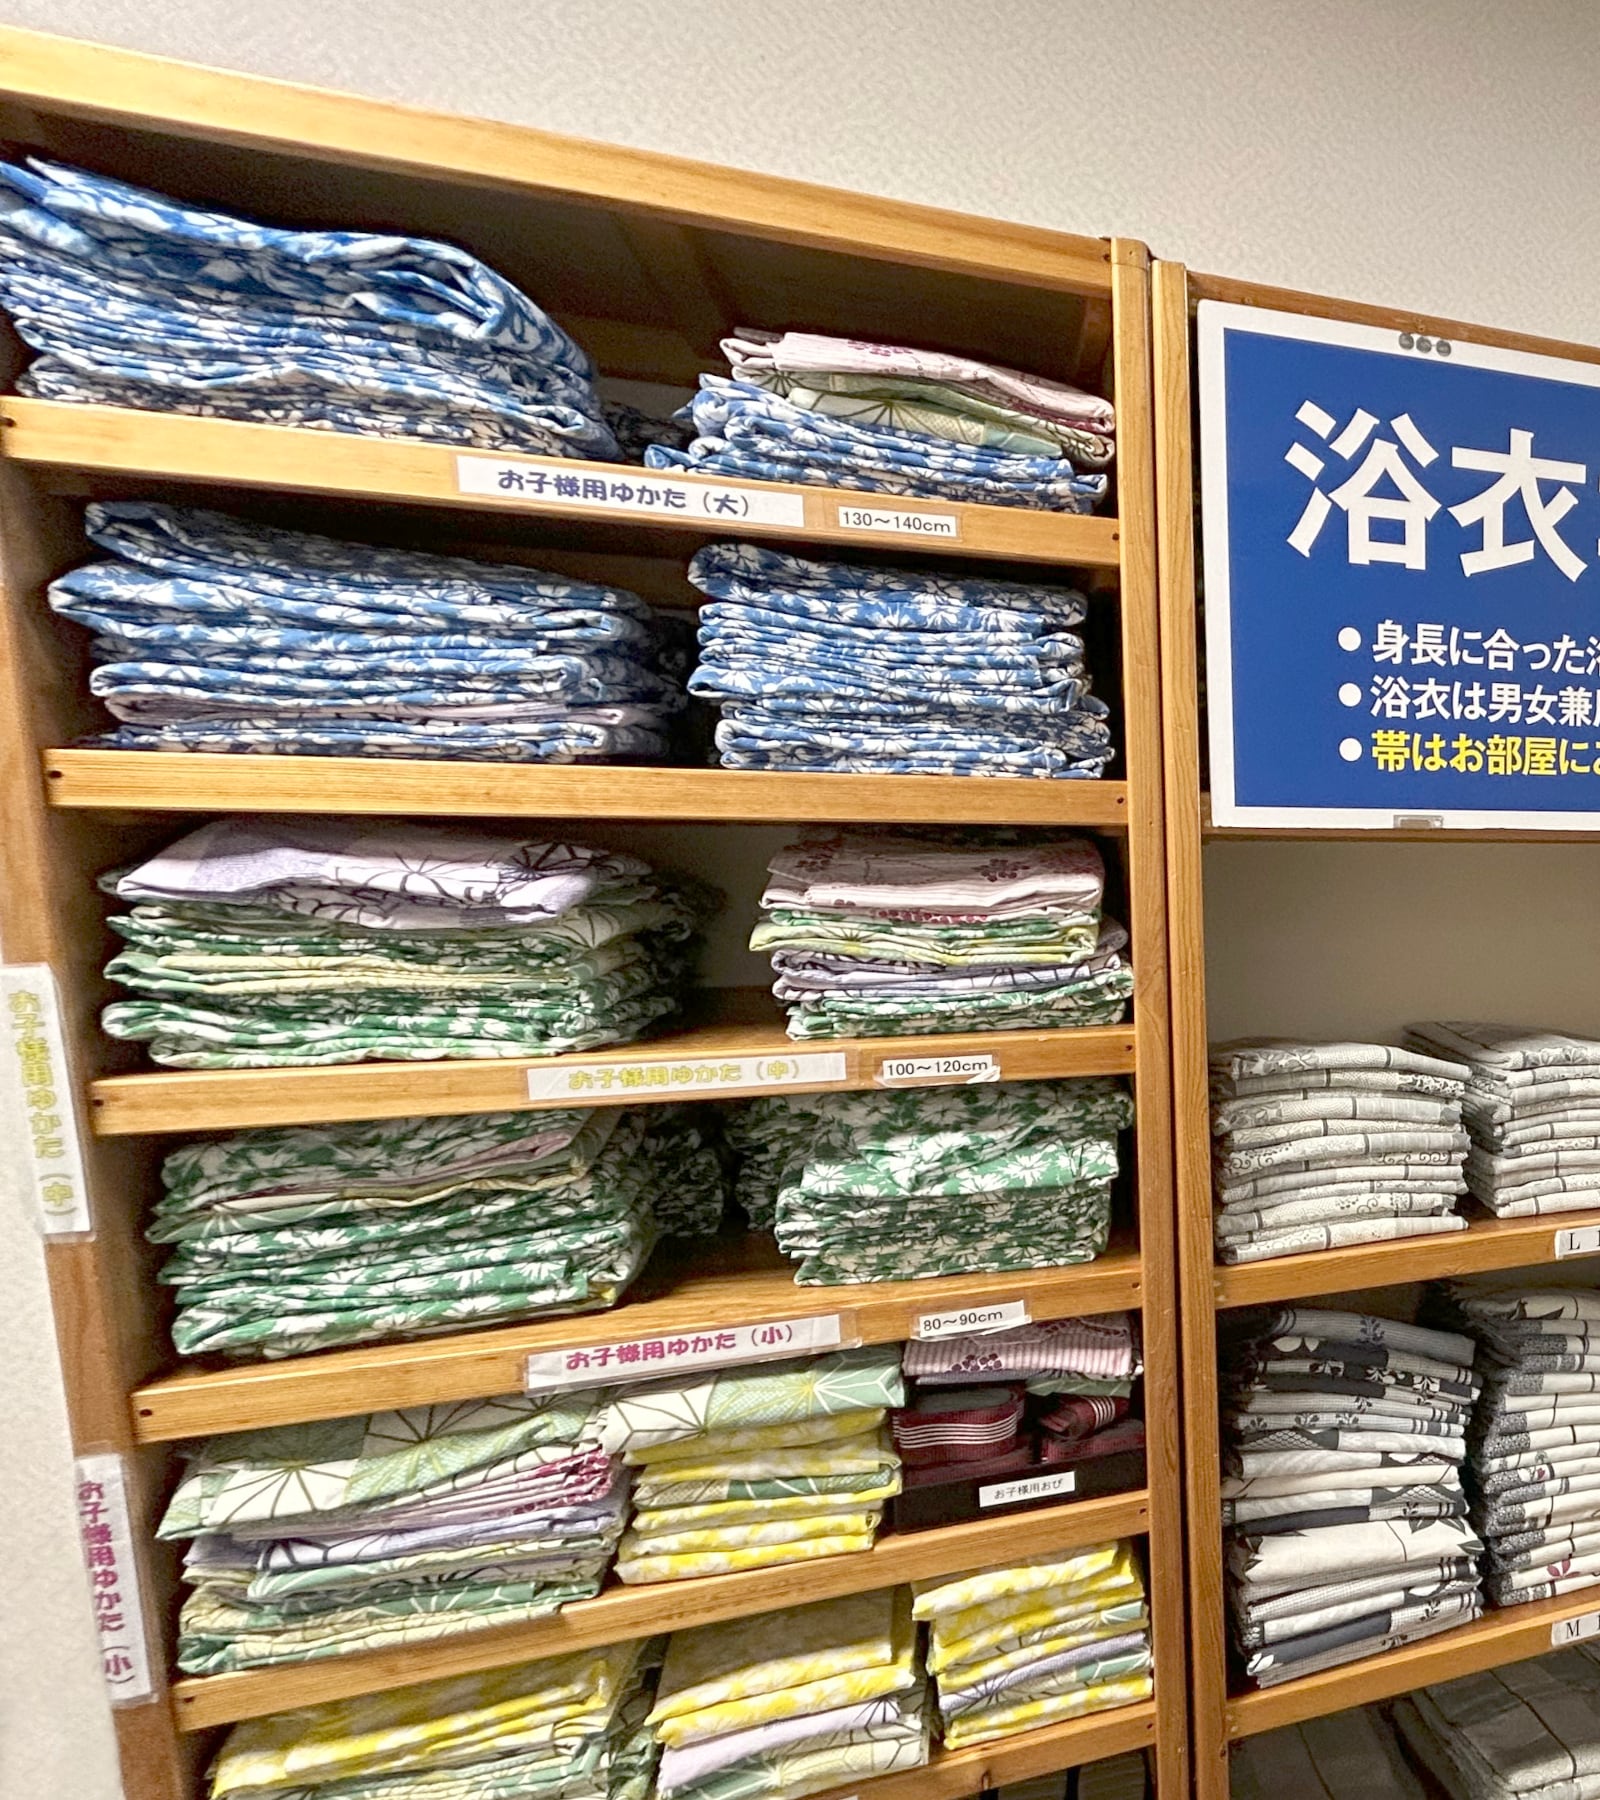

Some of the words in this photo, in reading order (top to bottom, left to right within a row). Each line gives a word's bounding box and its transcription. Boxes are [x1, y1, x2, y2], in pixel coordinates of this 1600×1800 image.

[498, 467, 750, 518] お子様用ゆかた（大）
[568, 1059, 800, 1090] お子様用ゆかた（中）
[8, 989, 78, 1217] お子様用ゆかた（中）
[1568, 1232, 1581, 1251] L
[565, 1323, 794, 1372] お子様用ゆかた（小）
[994, 1478, 1064, 1500] お子様用おび
[1564, 1620, 1582, 1639] M
